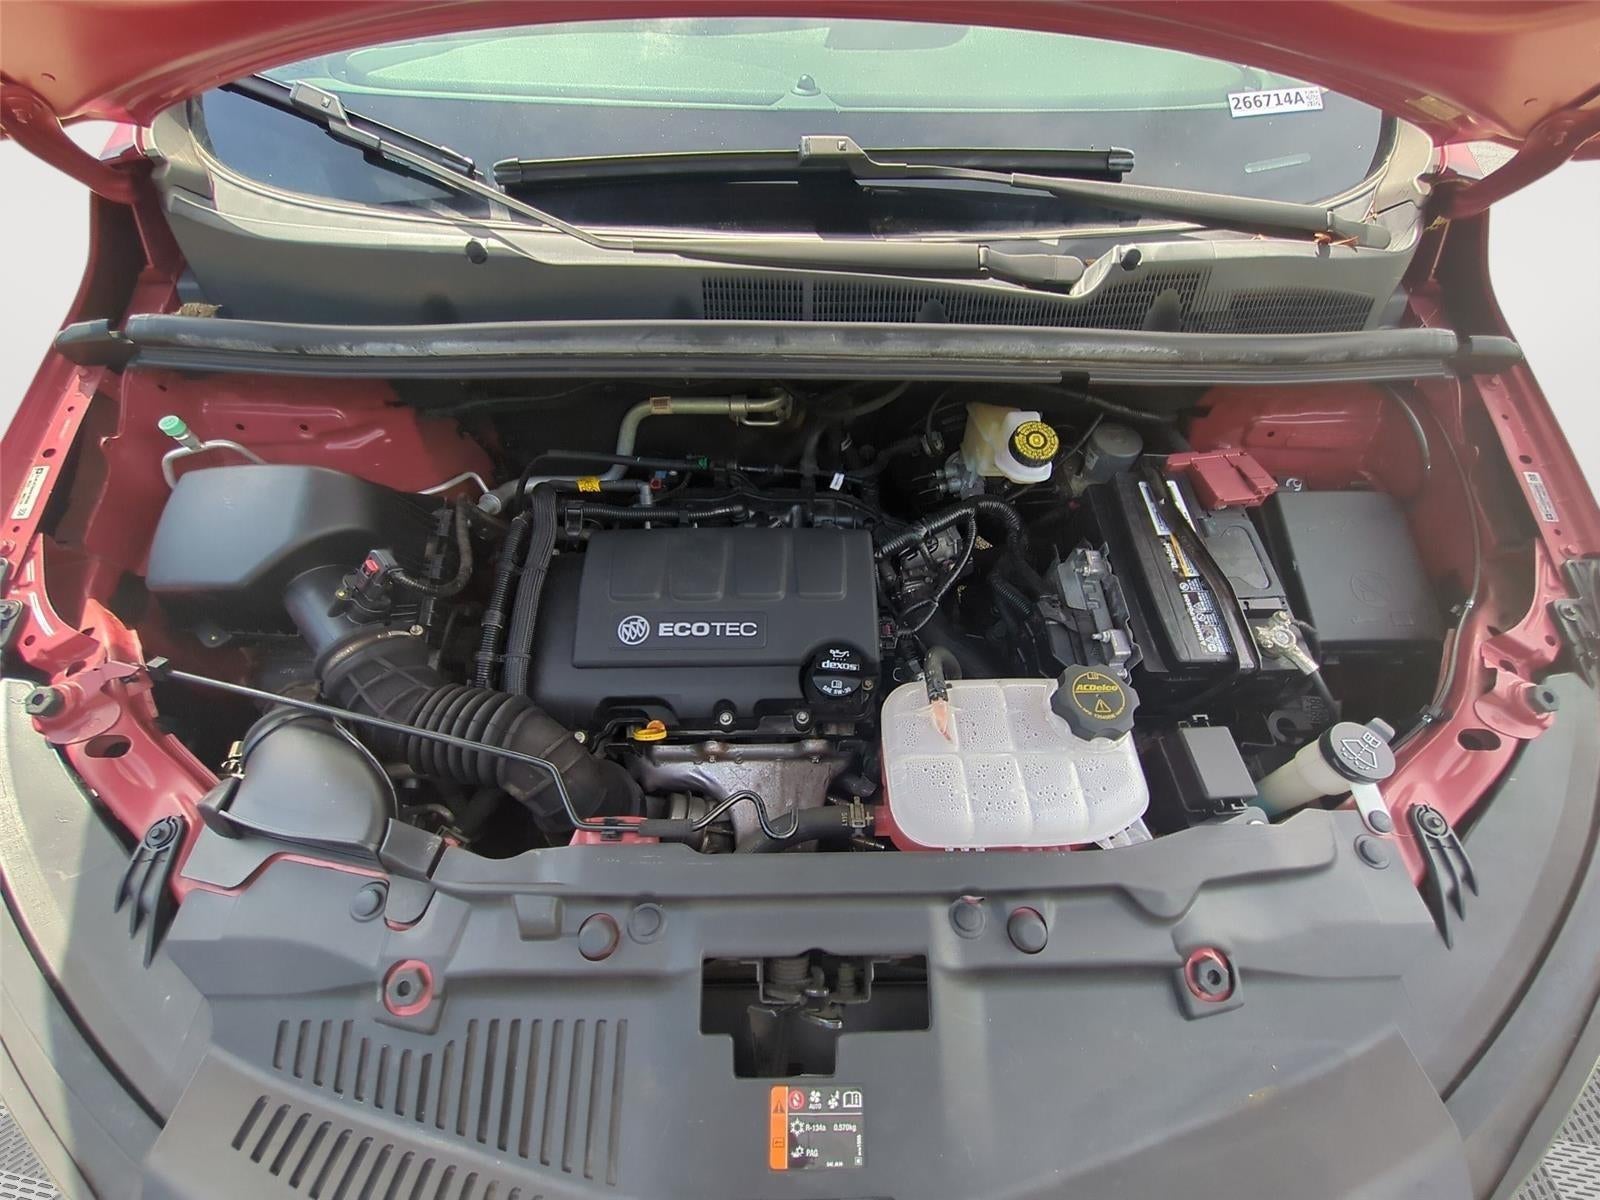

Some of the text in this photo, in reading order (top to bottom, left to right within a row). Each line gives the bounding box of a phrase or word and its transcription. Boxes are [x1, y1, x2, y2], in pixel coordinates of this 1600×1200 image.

[1232, 92, 1305, 110] 266714A
[658, 622, 757, 636] ECOTEC
[821, 660, 857, 670] dexos
